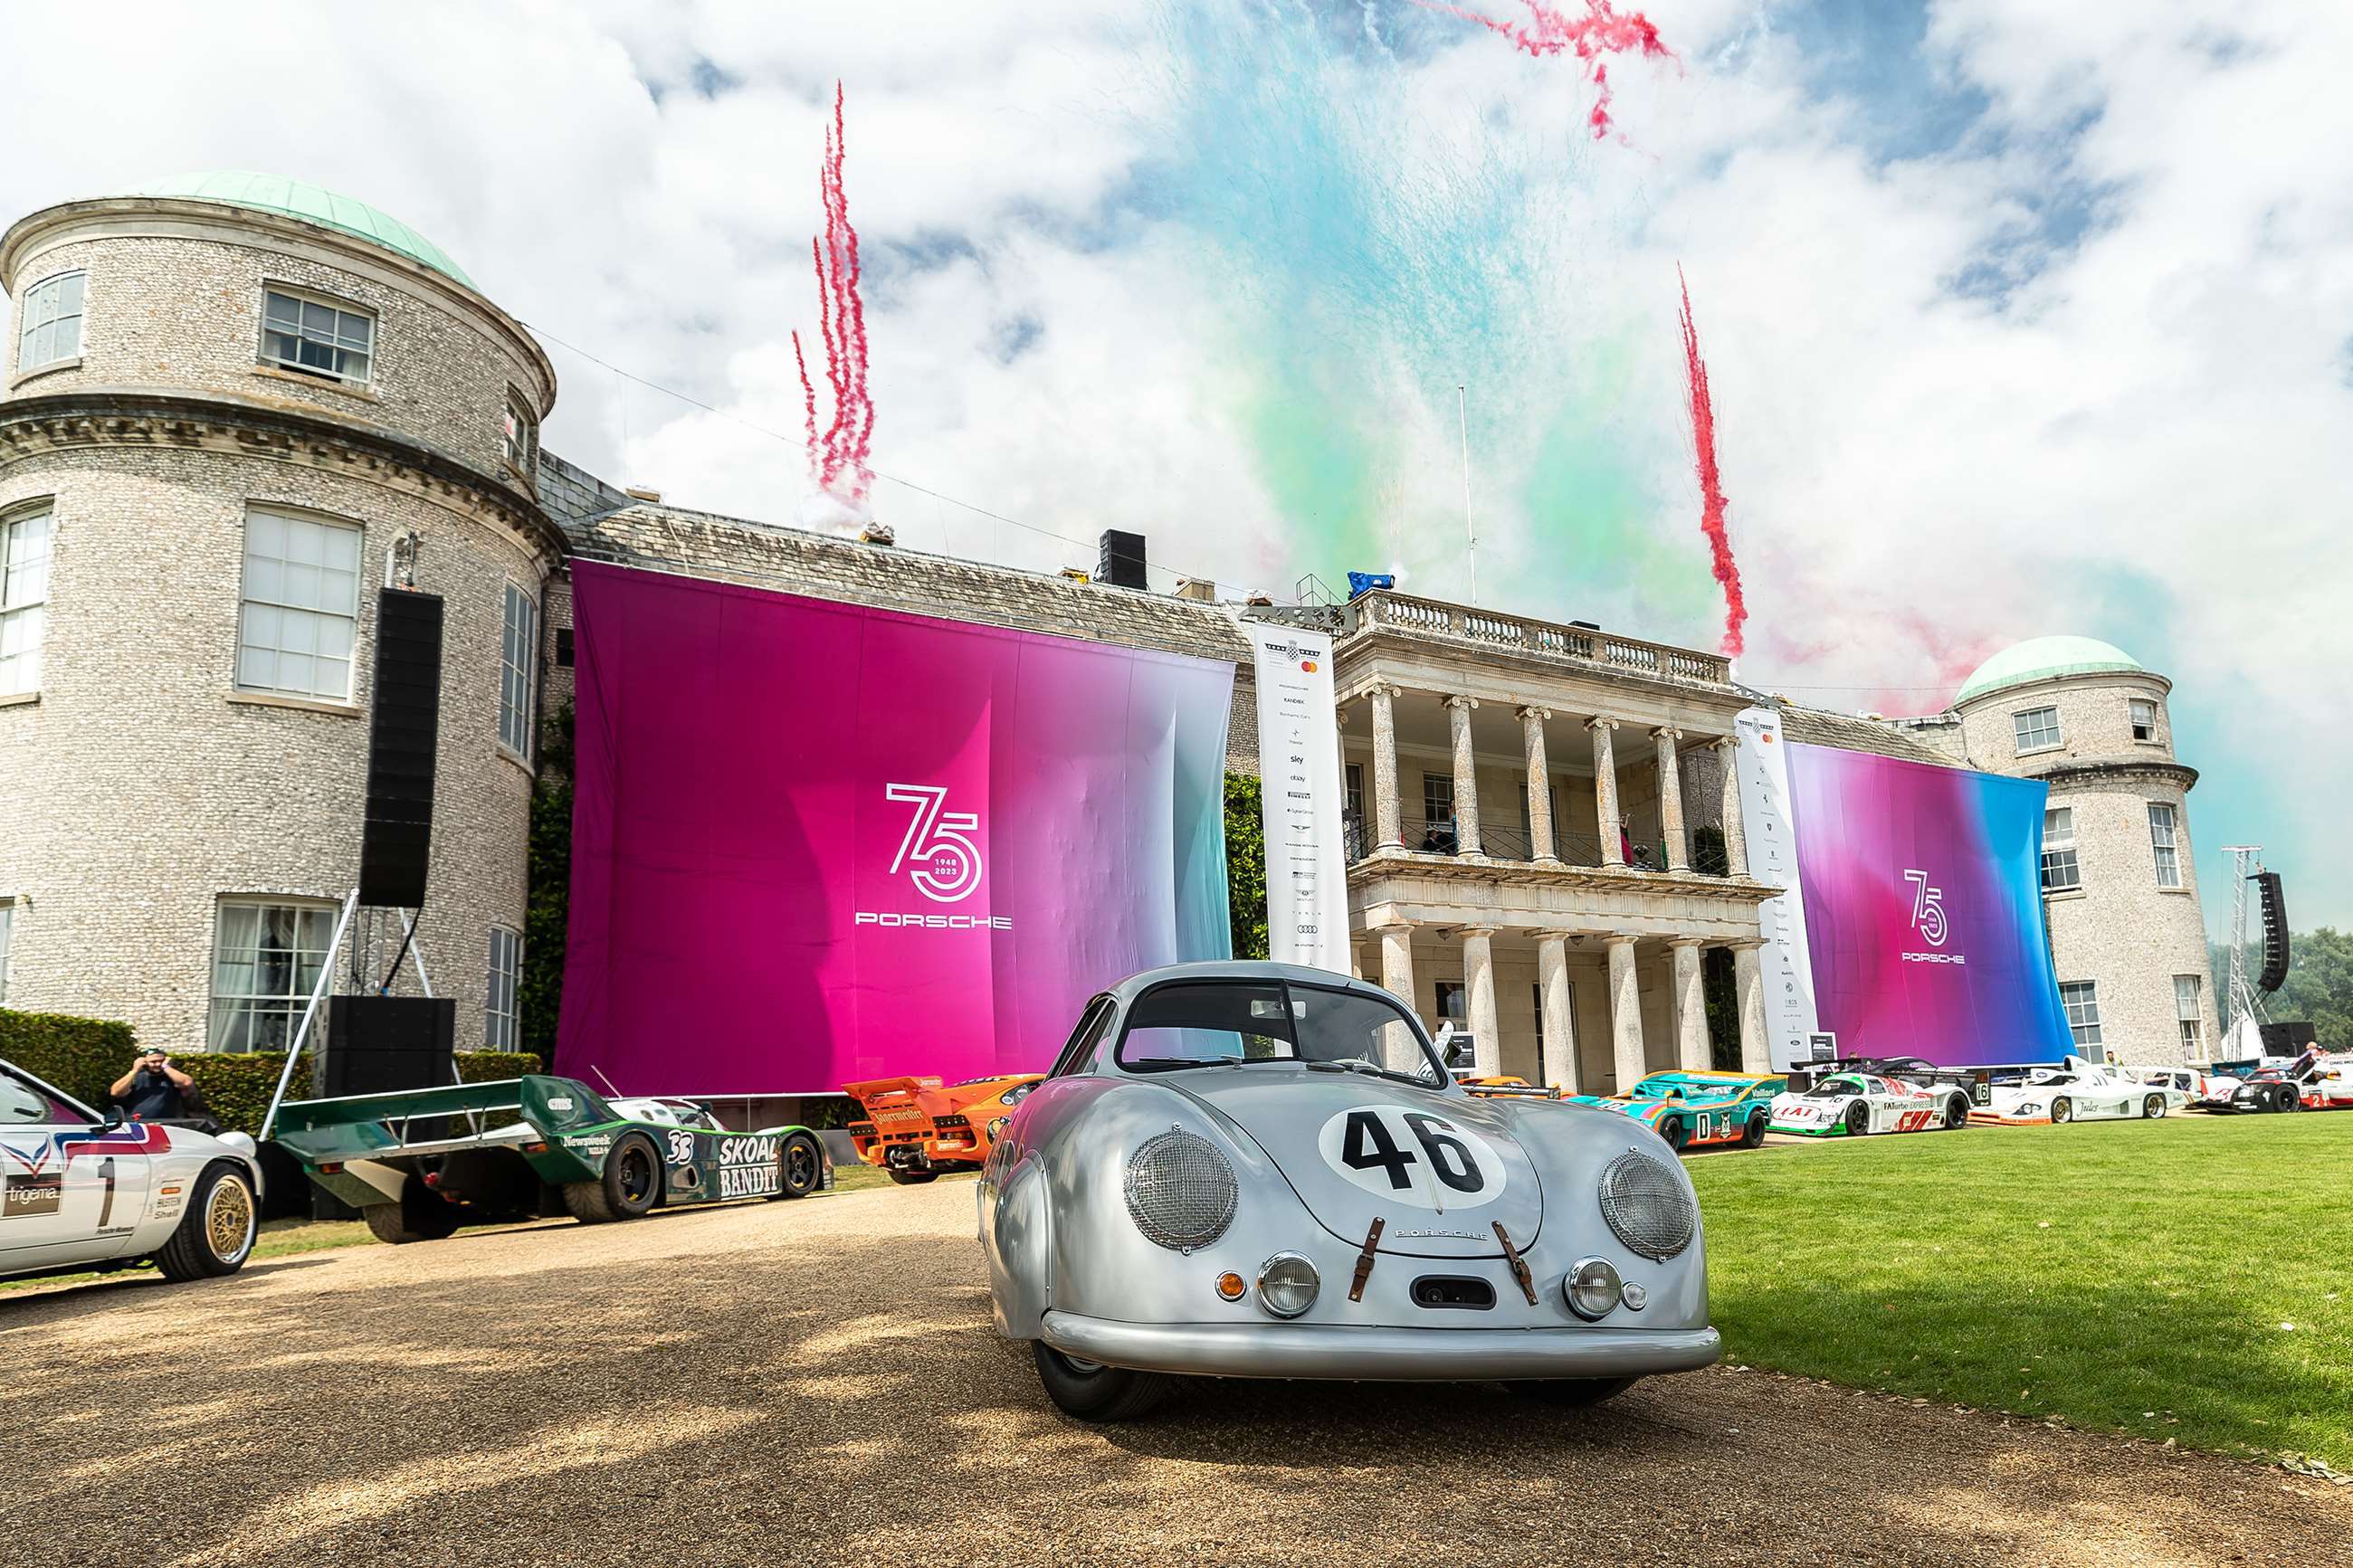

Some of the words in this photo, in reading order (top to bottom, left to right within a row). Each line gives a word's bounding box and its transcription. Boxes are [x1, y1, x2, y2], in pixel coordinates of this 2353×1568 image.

[1291, 755, 1304, 765] sky
[886, 784, 983, 903] 75
[934, 859, 957, 867] 1948
[934, 868, 957, 876] 2023
[1904, 869, 1948, 946] 75
[855, 912, 1013, 930] PORSCHE
[1901, 953, 1966, 965] PORSCHE
[1977, 1085, 1989, 1100] 16
[2313, 1095, 2320, 1107] 2
[563, 1135, 612, 1147] Newsweek
[667, 1129, 695, 1165] 33
[719, 1136, 778, 1165] SKOAL
[1341, 1110, 1485, 1193] 46
[719, 1166, 779, 1197] BANDIT
[5, 1184, 62, 1205] trigema
[97, 1156, 116, 1227] 1
[1395, 1230, 1489, 1240] PORSCHE
